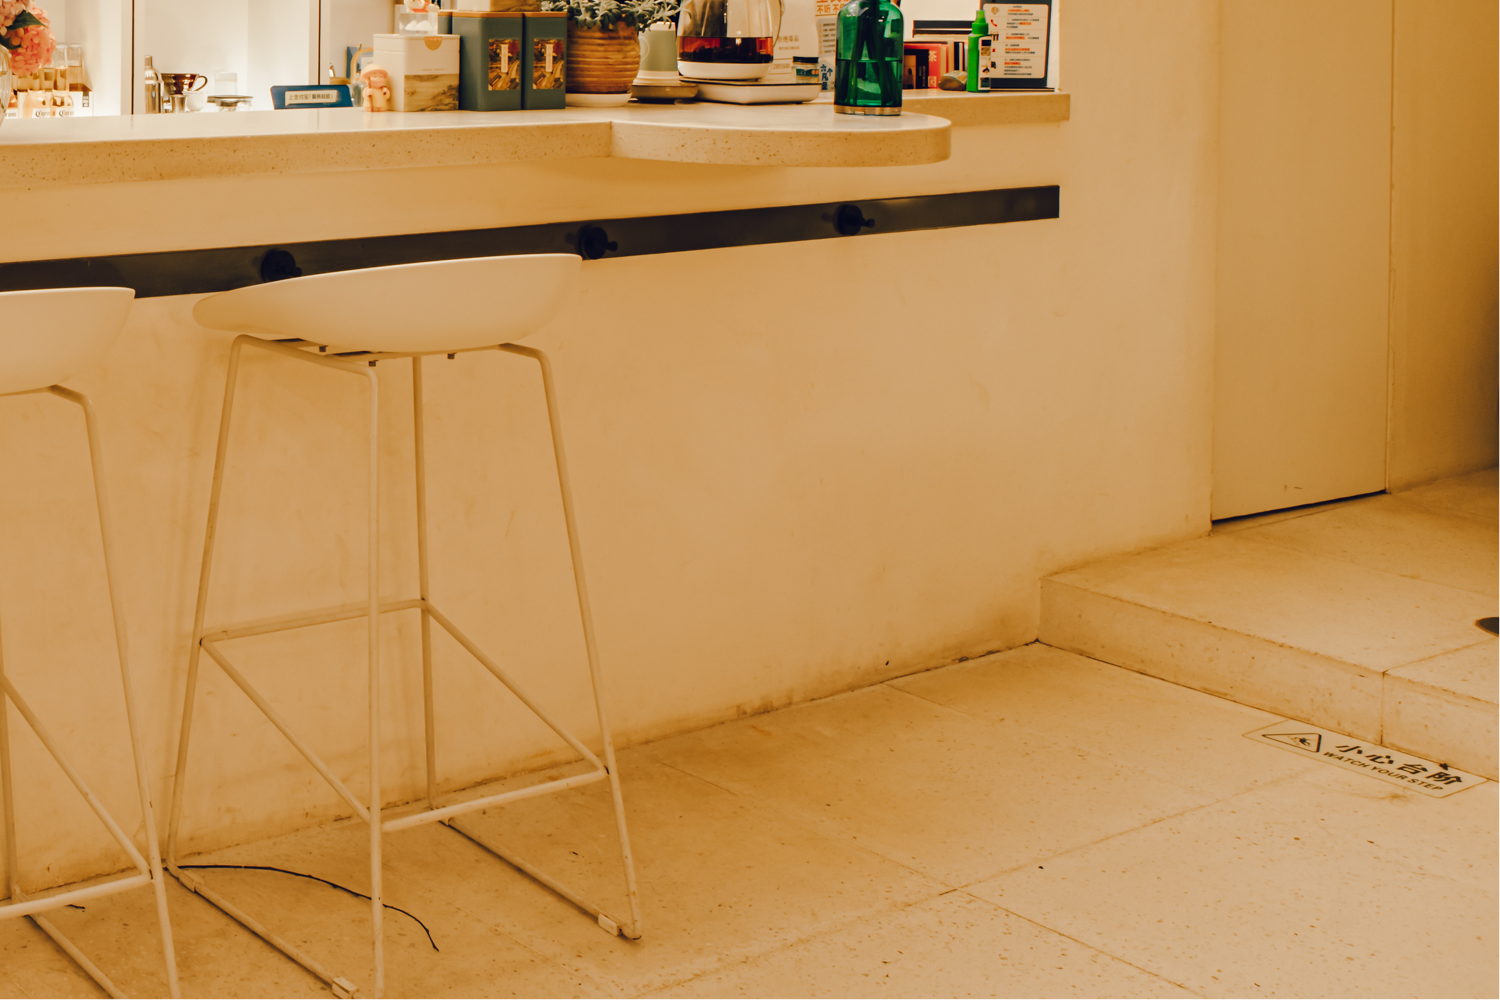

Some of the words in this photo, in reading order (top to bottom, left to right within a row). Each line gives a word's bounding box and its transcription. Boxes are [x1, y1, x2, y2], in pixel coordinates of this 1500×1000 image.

[1323, 751, 1370, 769] WATCH
[1370, 766, 1409, 781] YOUR
[1408, 777, 1444, 792] STEP
[1335, 744, 1463, 786] 小心台阶
